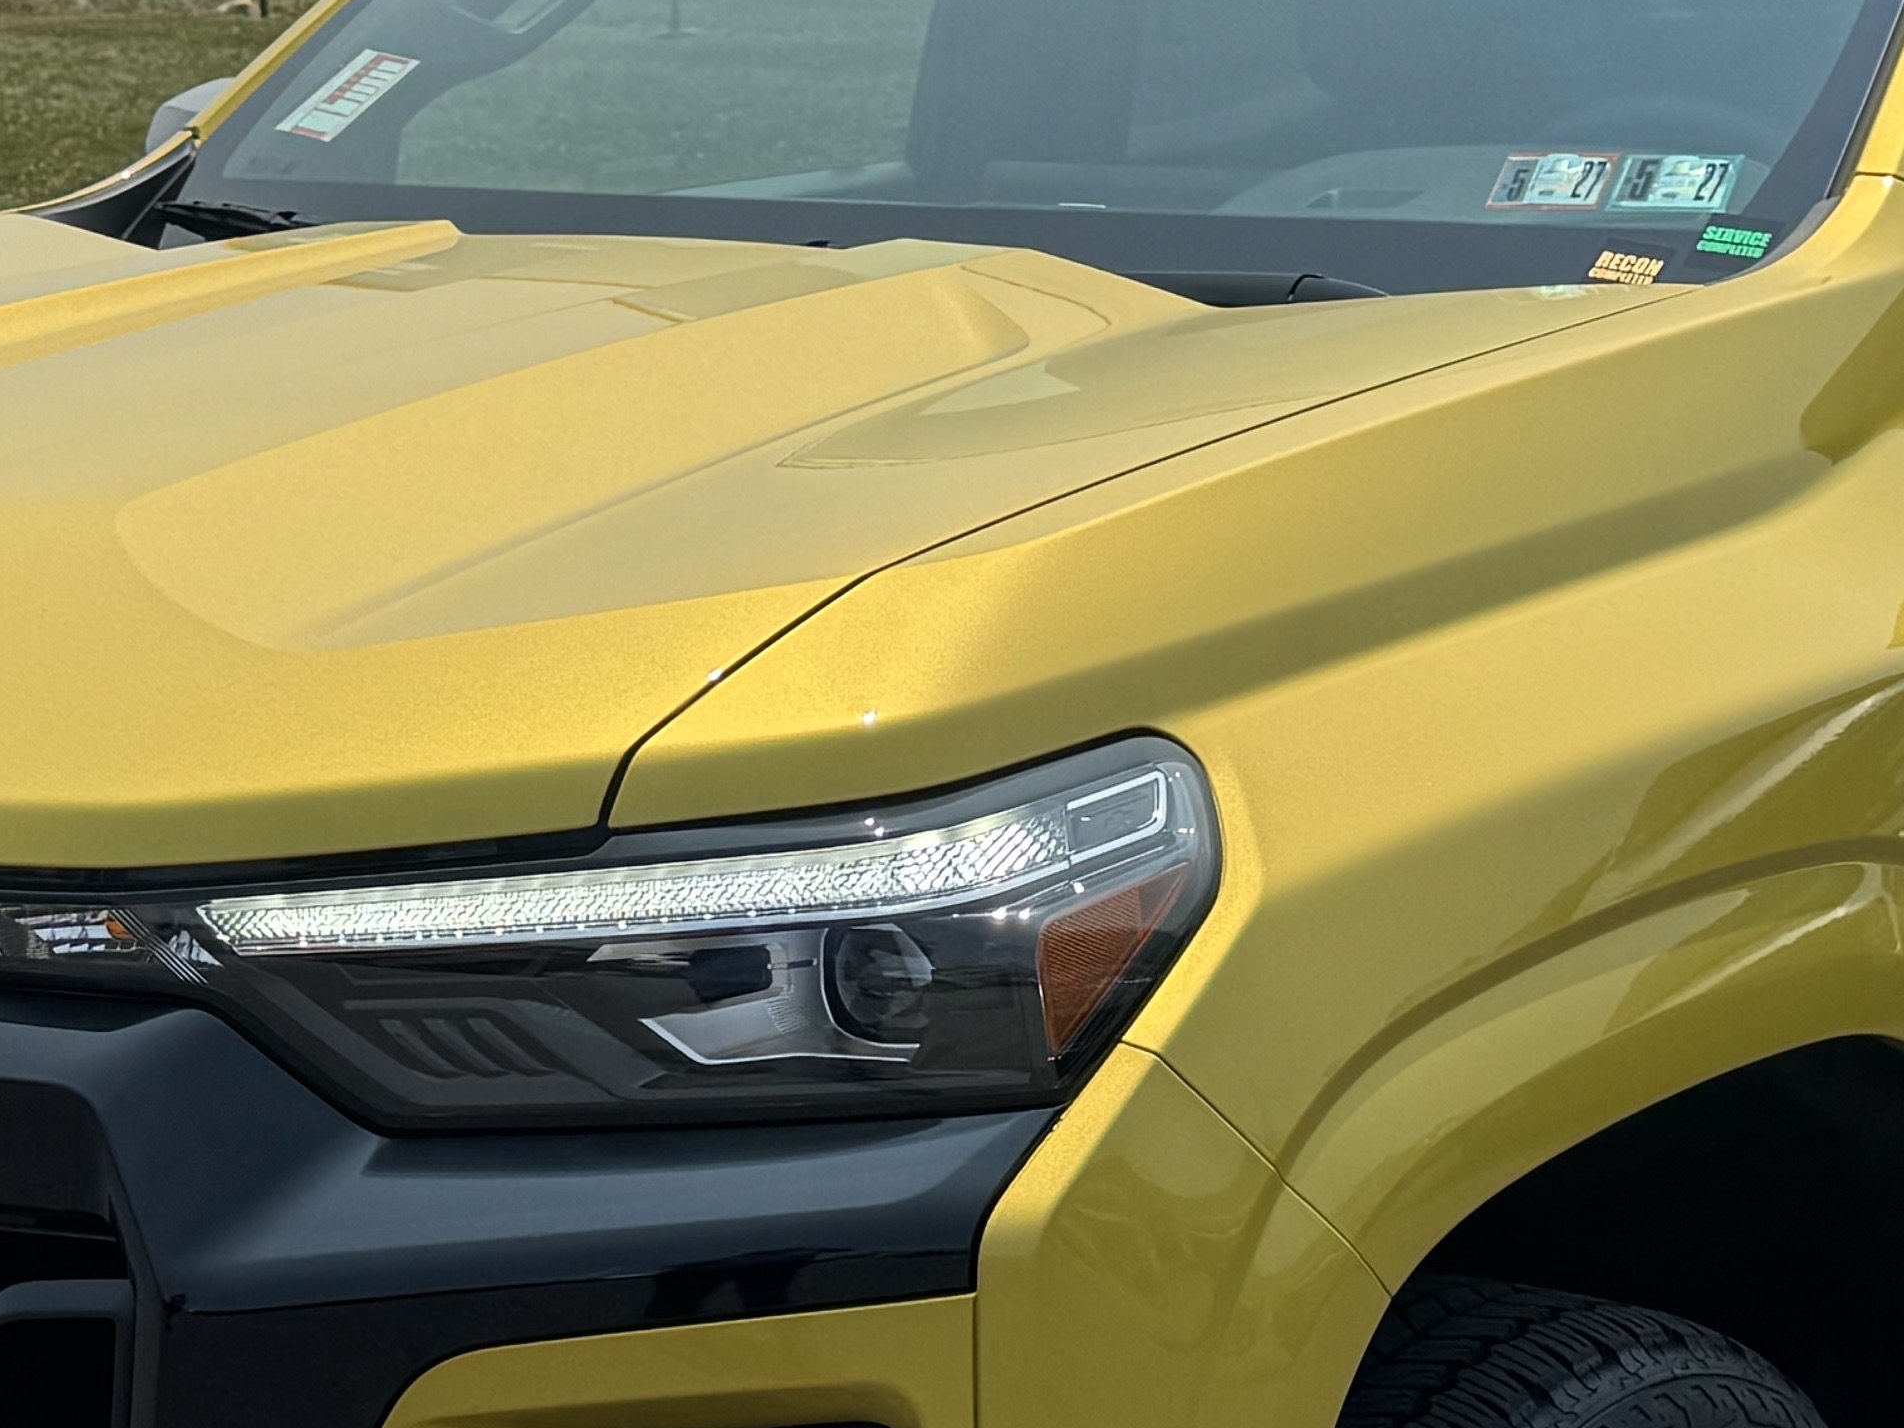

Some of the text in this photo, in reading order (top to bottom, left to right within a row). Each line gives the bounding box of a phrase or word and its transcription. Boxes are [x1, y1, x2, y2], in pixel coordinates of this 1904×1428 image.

[1570, 160, 1608, 202] 27
[1692, 162, 1730, 203] 27
[1702, 225, 1773, 248] SERVICE
[1594, 250, 1665, 277] RECON
